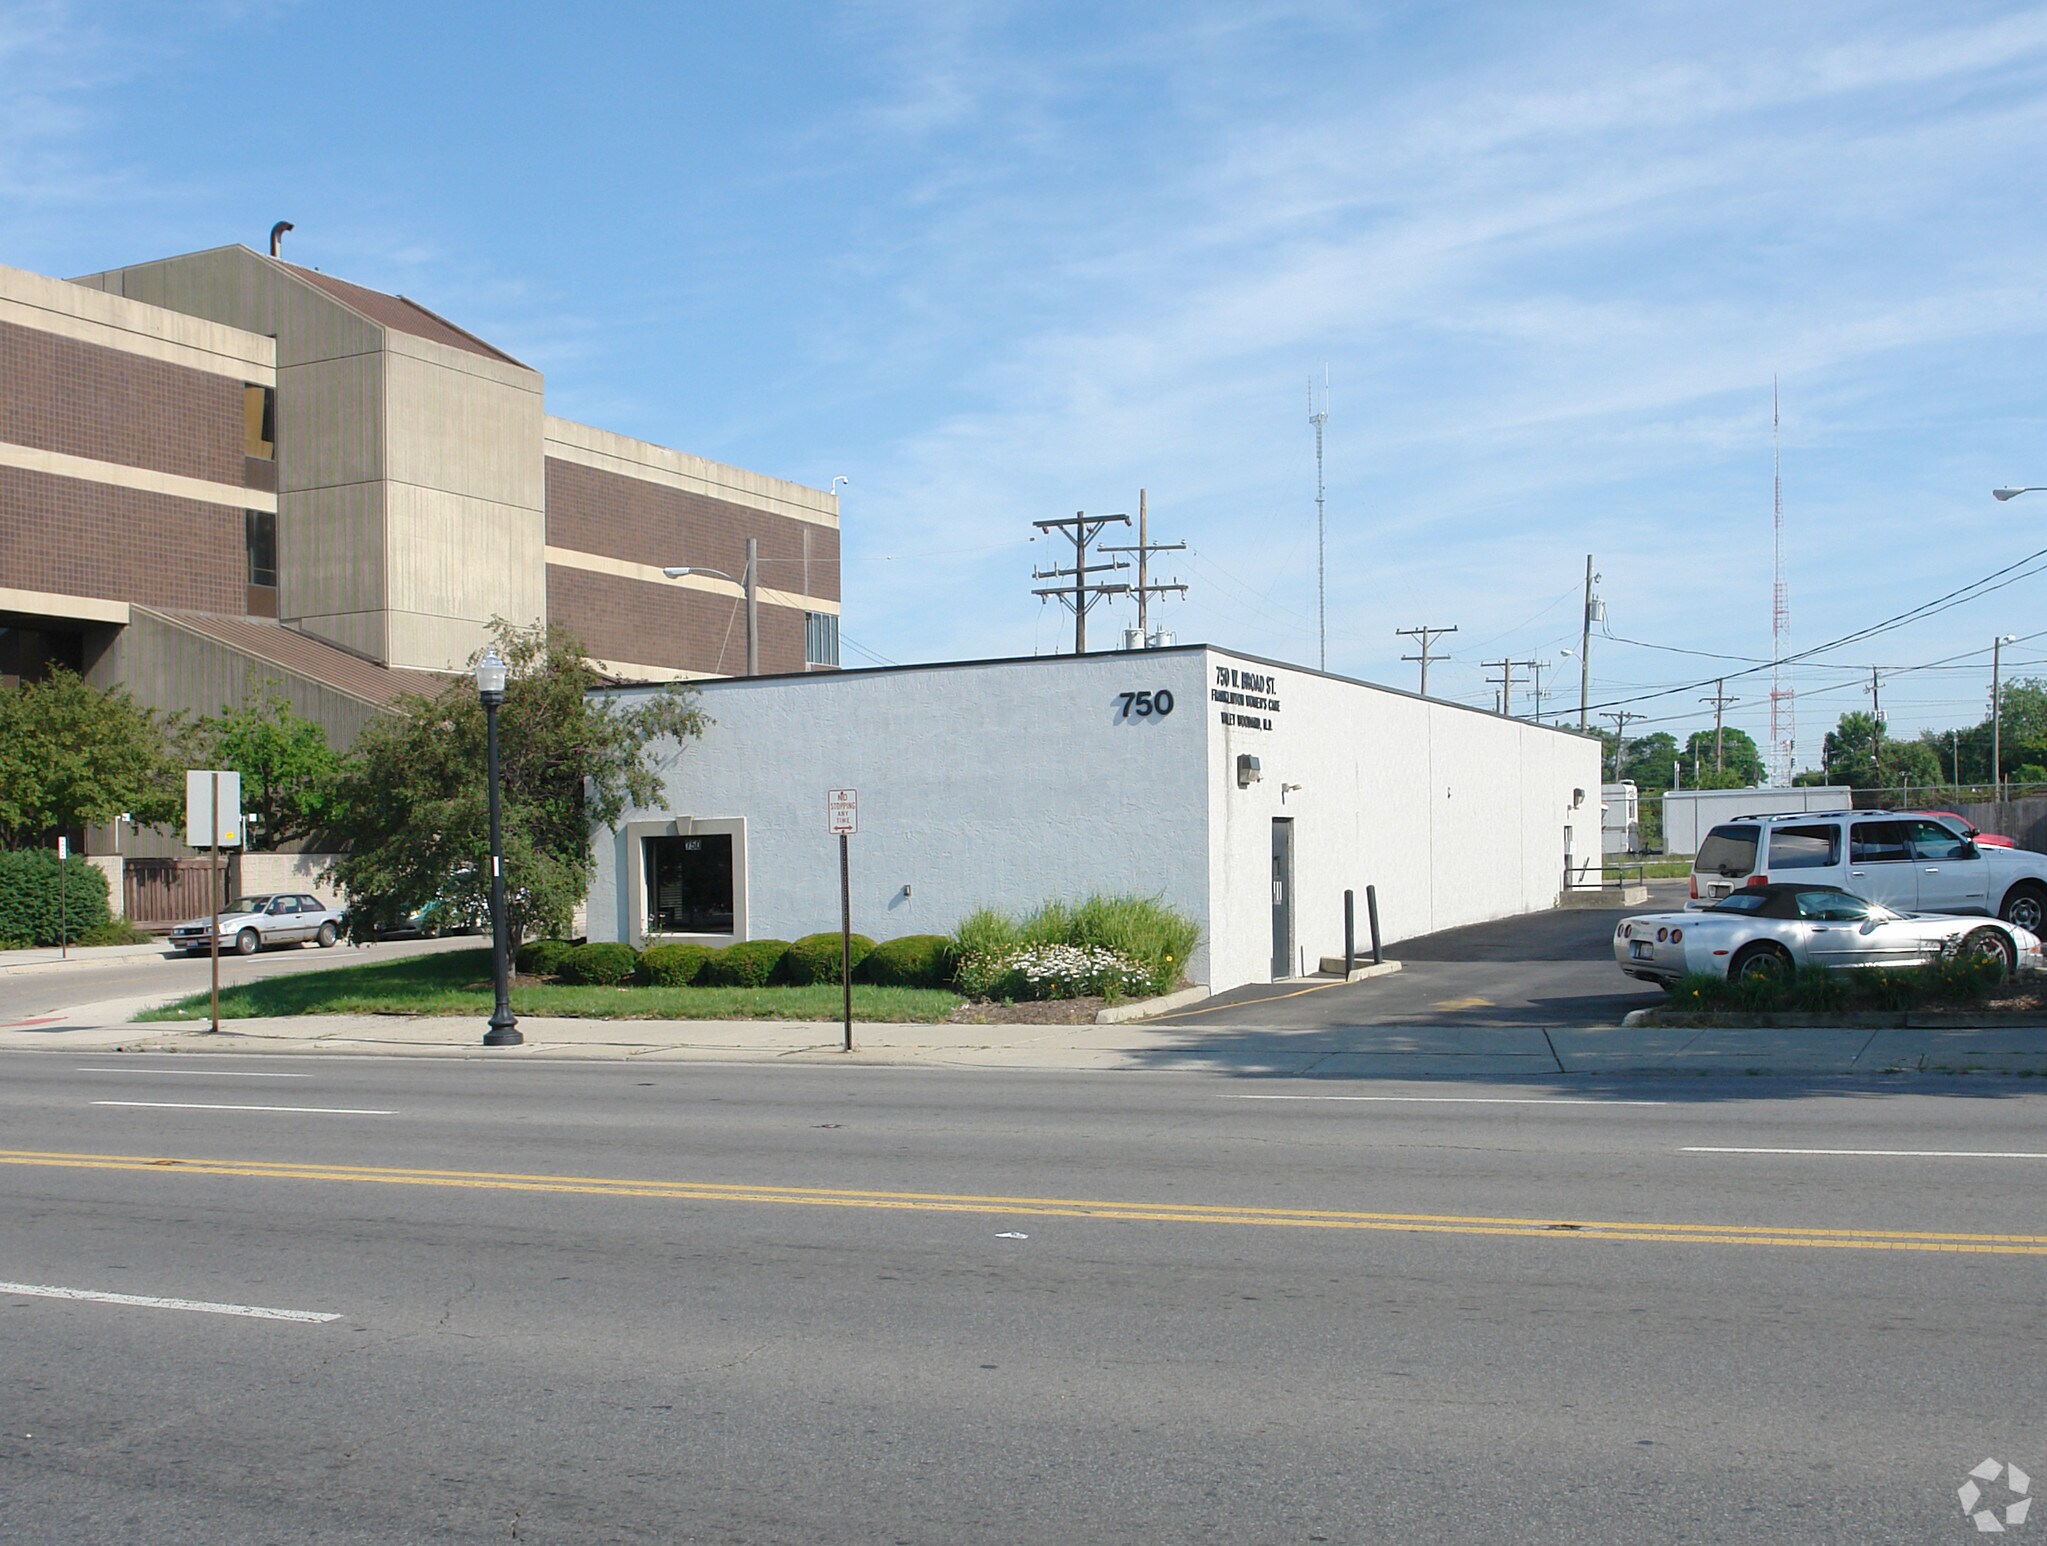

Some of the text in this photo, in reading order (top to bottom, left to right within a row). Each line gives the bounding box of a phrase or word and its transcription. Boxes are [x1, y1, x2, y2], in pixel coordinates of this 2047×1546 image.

[1216, 666, 1277, 695] 750 W. BROAD ST.
[1119, 689, 1174, 717] 750
[1245, 695, 1267, 710] WOMEN'S
[837, 793, 848, 801] NO
[830, 802, 856, 810] STOPPING
[685, 840, 702, 850] 750
